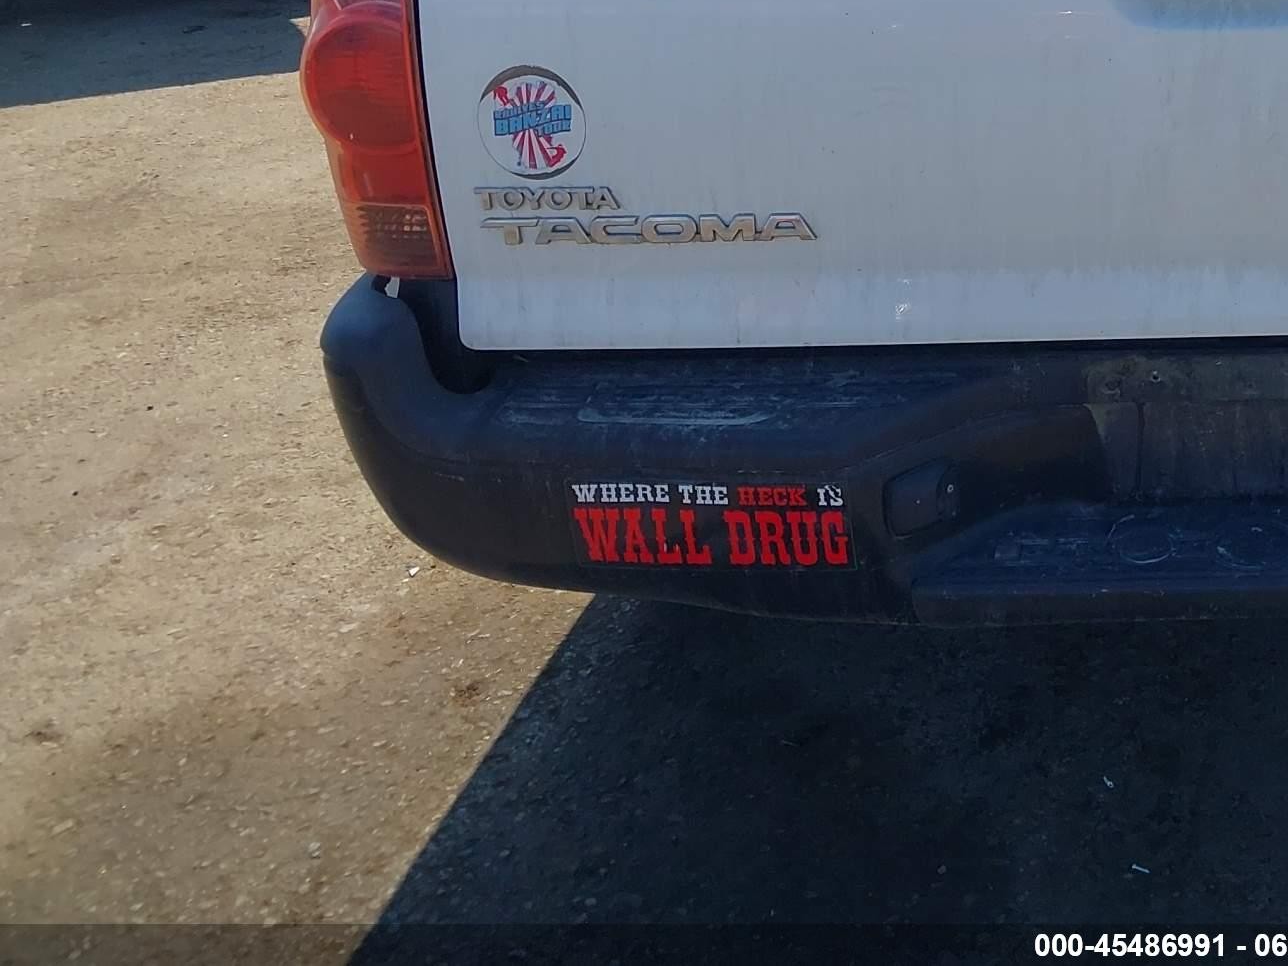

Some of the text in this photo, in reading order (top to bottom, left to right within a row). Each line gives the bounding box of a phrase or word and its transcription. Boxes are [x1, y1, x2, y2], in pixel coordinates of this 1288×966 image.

[494, 104, 571, 136] BANZAI
[474, 187, 621, 210] TOYOTA
[480, 213, 817, 246] TACOMA
[572, 484, 843, 507] WHERE THE HECK IS
[573, 508, 849, 566] WALL DRUG
